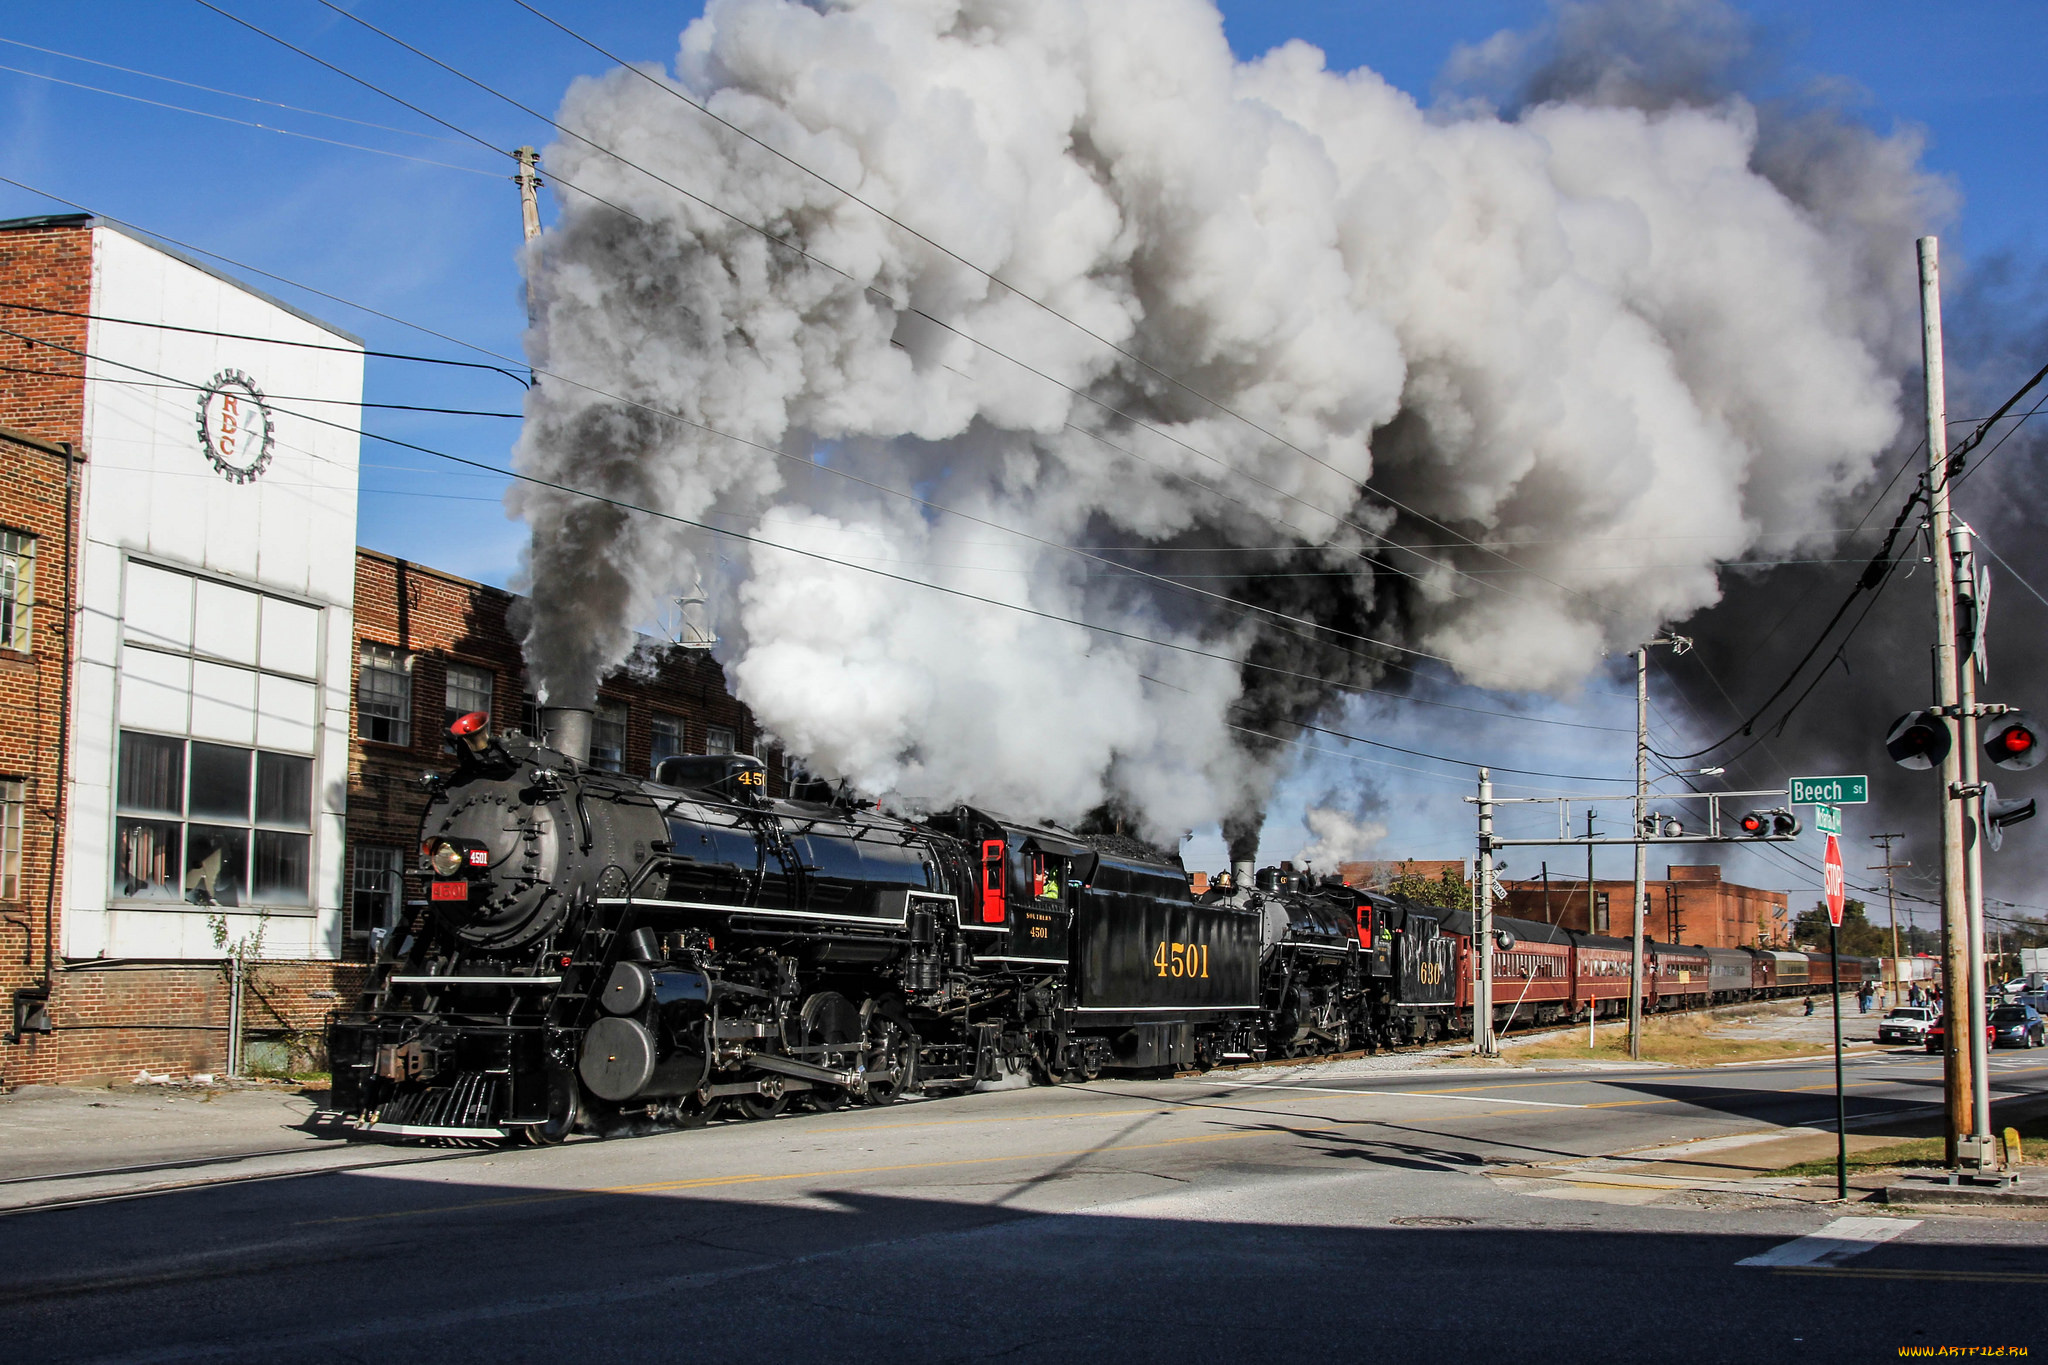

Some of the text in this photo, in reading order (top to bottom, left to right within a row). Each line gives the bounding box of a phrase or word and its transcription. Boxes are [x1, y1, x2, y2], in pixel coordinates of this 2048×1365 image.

[220, 393, 240, 455] RDC
[1794, 780, 1863, 801] Beech St
[470, 852, 488, 865] 4501
[1826, 863, 1842, 897] STOP
[434, 885, 465, 898] 4501
[1030, 926, 1048, 939] 4501
[1153, 941, 1210, 979] 4501
[1420, 961, 1441, 985] 630
